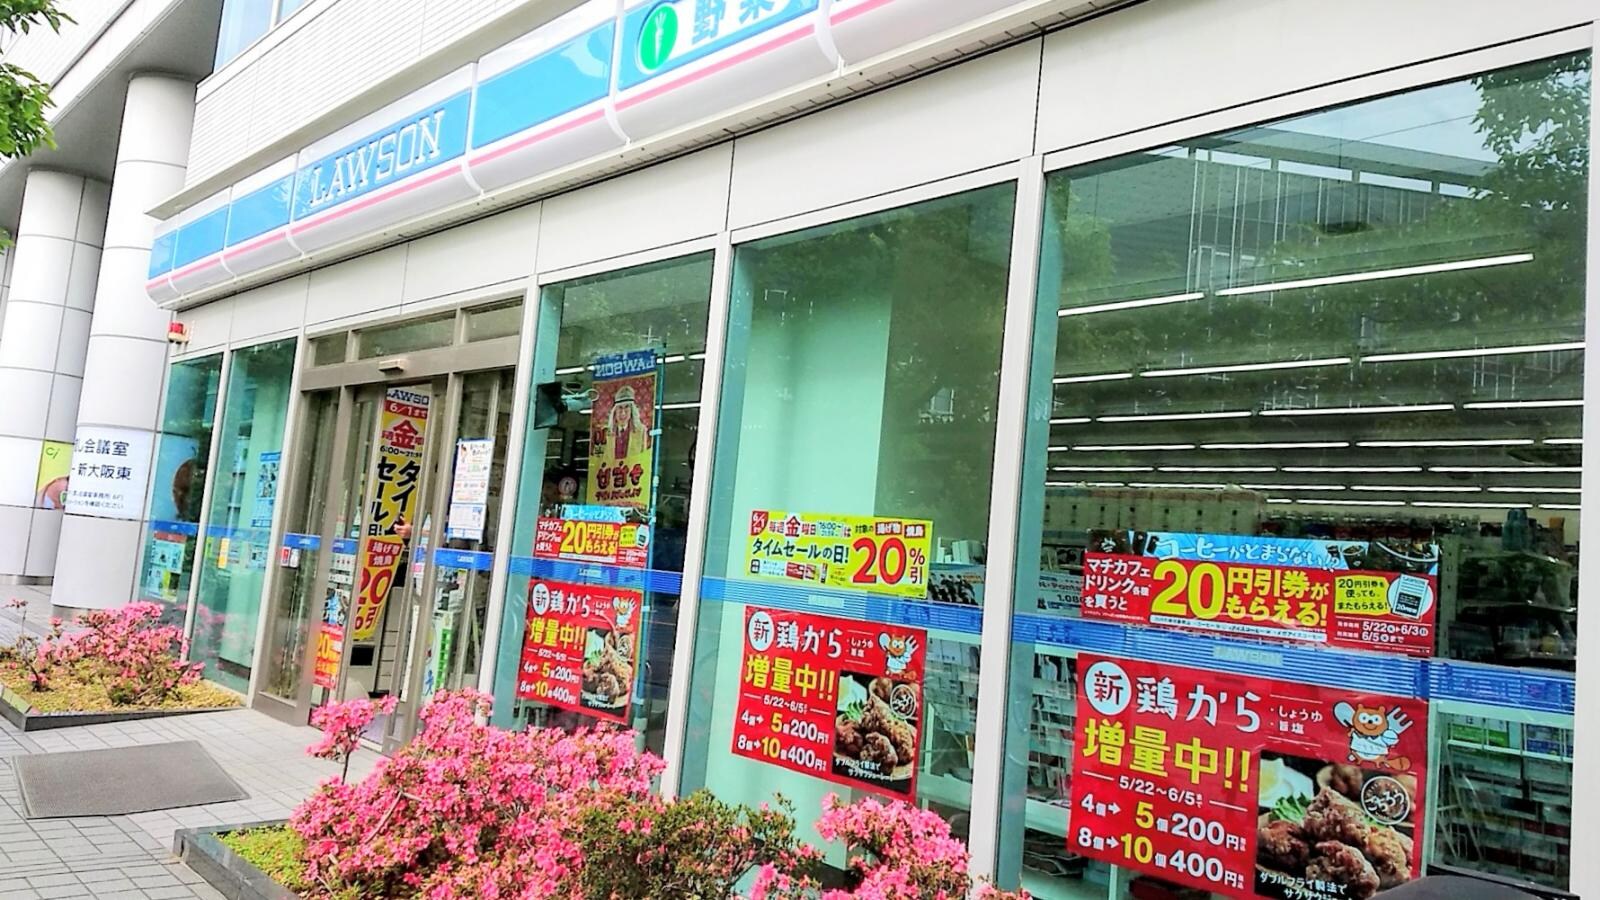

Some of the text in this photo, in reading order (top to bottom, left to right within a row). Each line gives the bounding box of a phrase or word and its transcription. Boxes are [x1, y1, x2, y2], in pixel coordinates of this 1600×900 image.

[310, 107, 445, 208] LAWSON
[560, 521, 587, 554] 20
[752, 538, 849, 563] タイムセールの日!
[853, 537, 907, 585] 20
[1086, 558, 1151, 578] マチカフェ
[1084, 594, 1128, 611] を買うと
[1151, 560, 1226, 620] 20
[1226, 594, 1327, 627] もらえる!
[530, 617, 586, 651] 増量中!!
[776, 620, 843, 658] 鶏から
[745, 654, 835, 701] 増量中!!
[1136, 676, 1262, 733] 鶏から
[1083, 717, 1250, 792] 増量中!!
